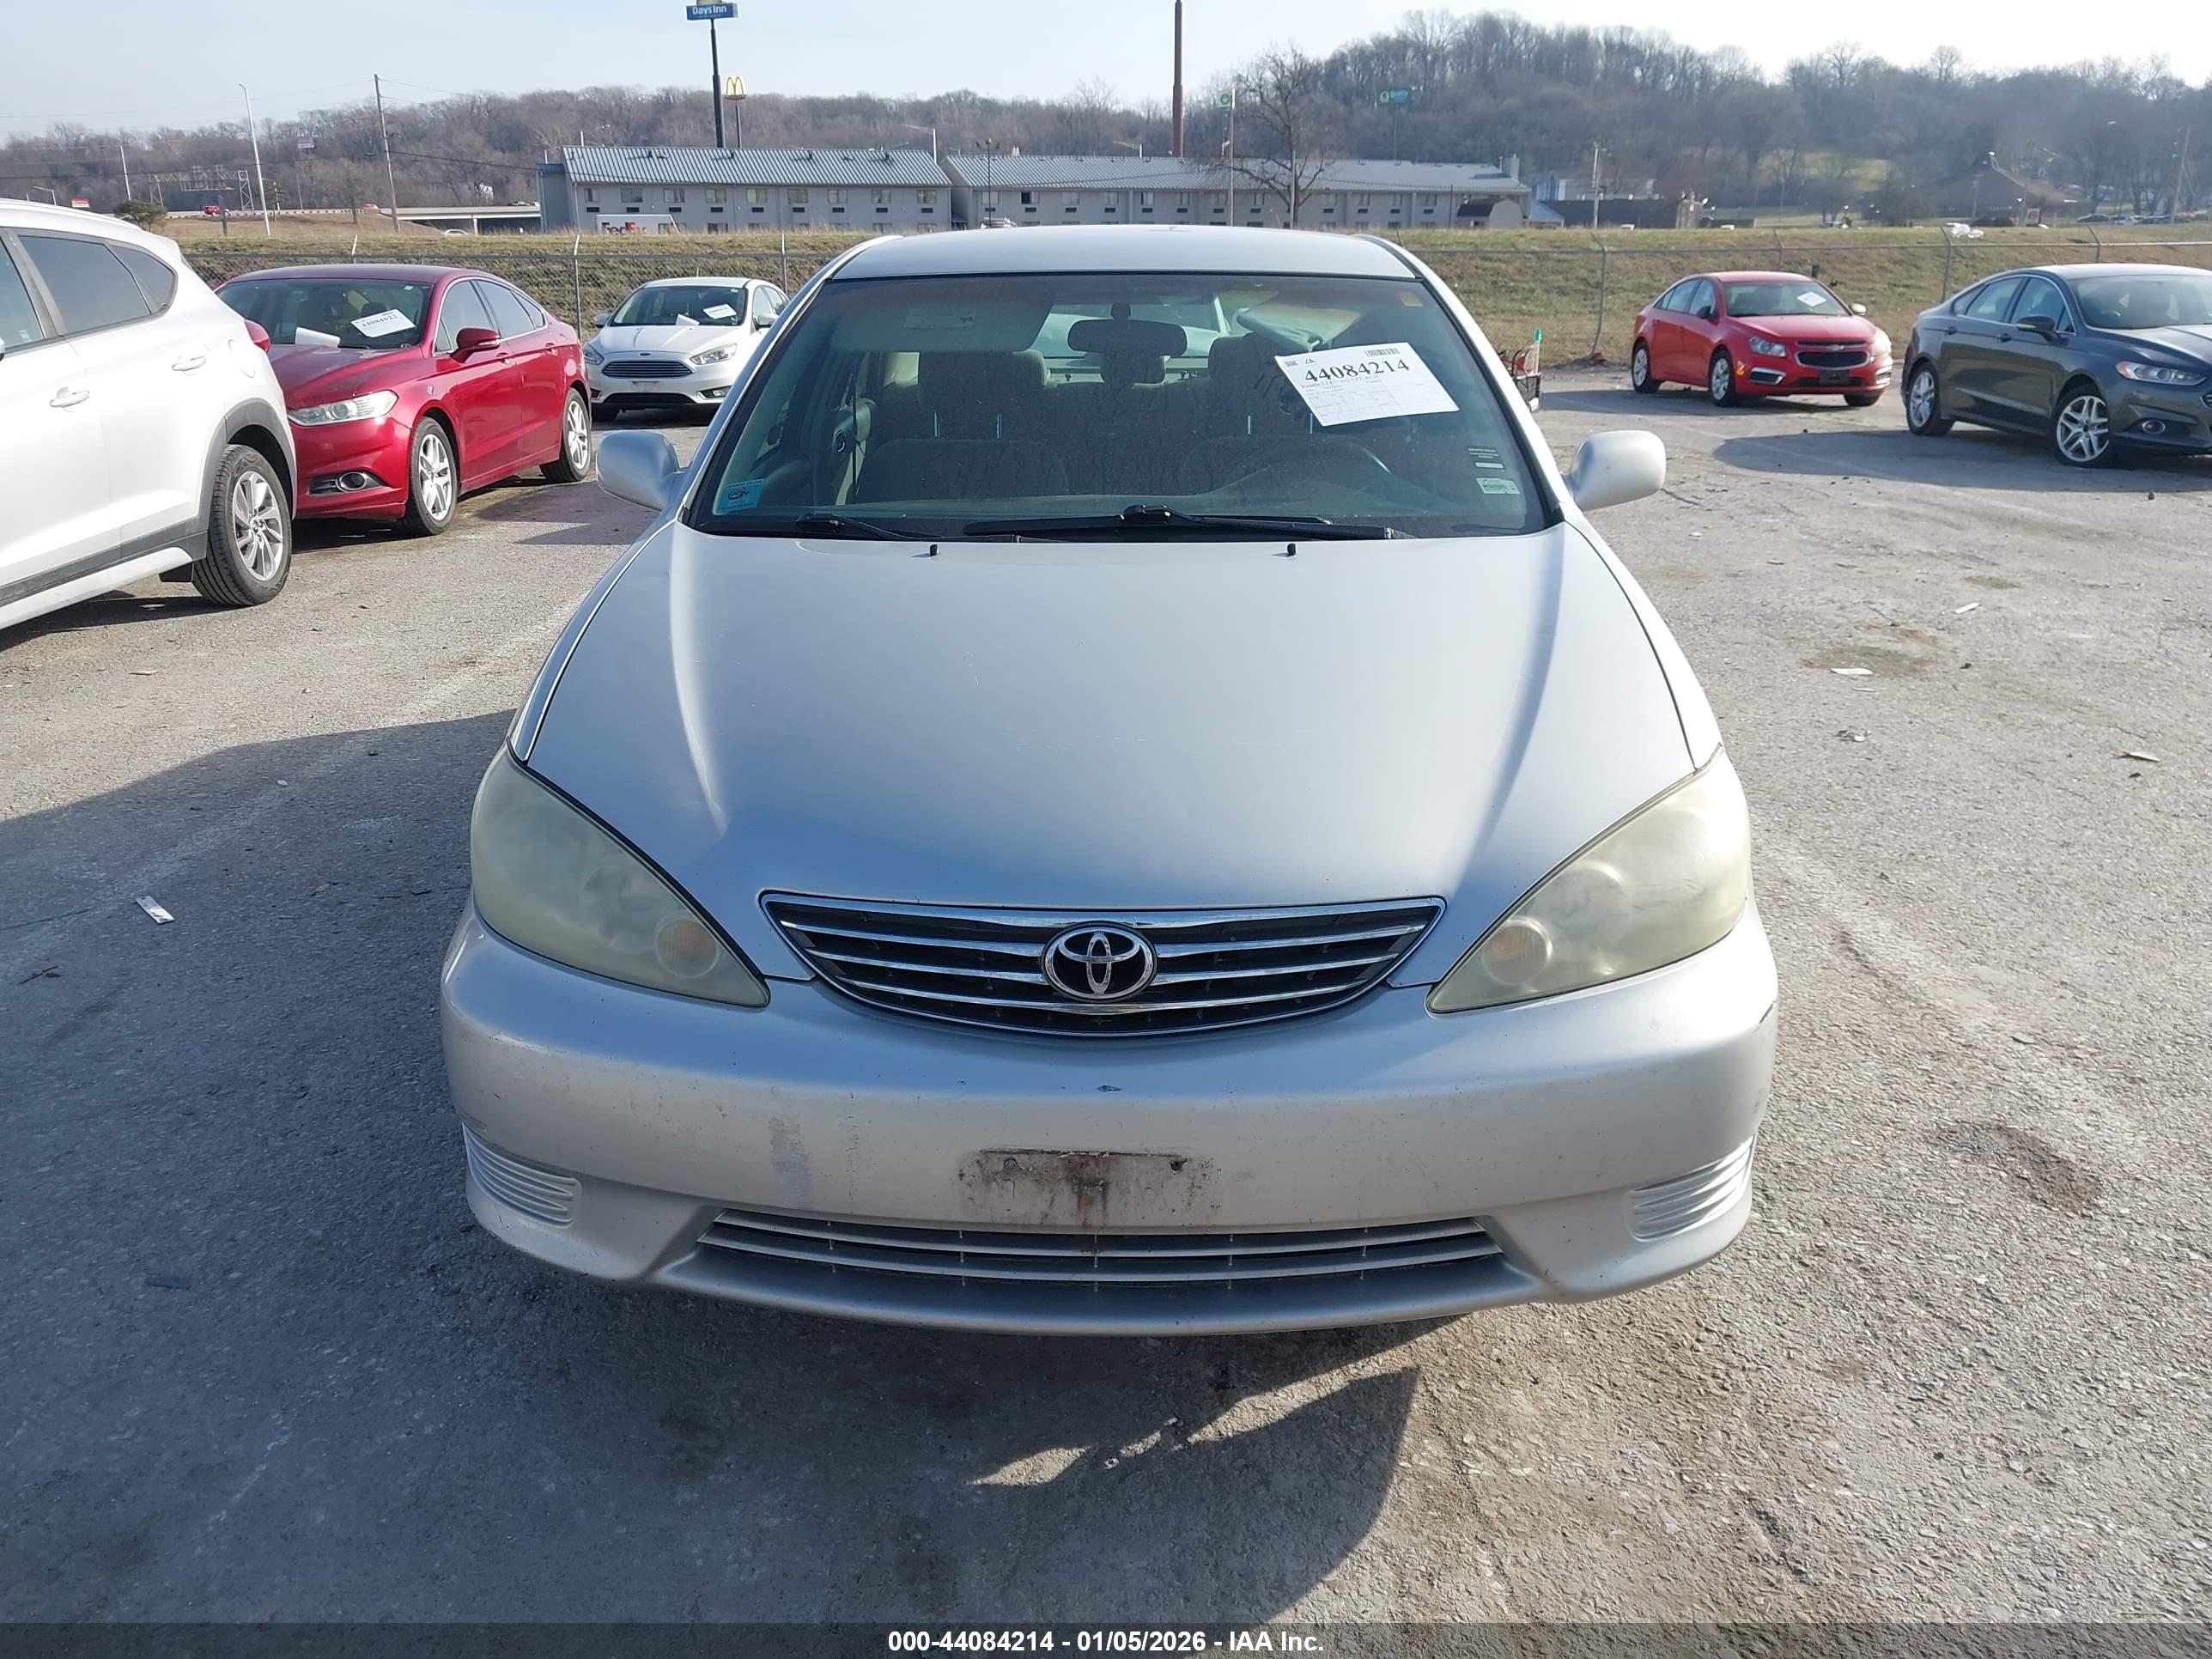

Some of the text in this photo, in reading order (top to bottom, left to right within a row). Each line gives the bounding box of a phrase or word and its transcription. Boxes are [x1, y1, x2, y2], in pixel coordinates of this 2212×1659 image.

[692, 5, 727, 15] Days Inn
[1304, 359, 1410, 382] 44084214
